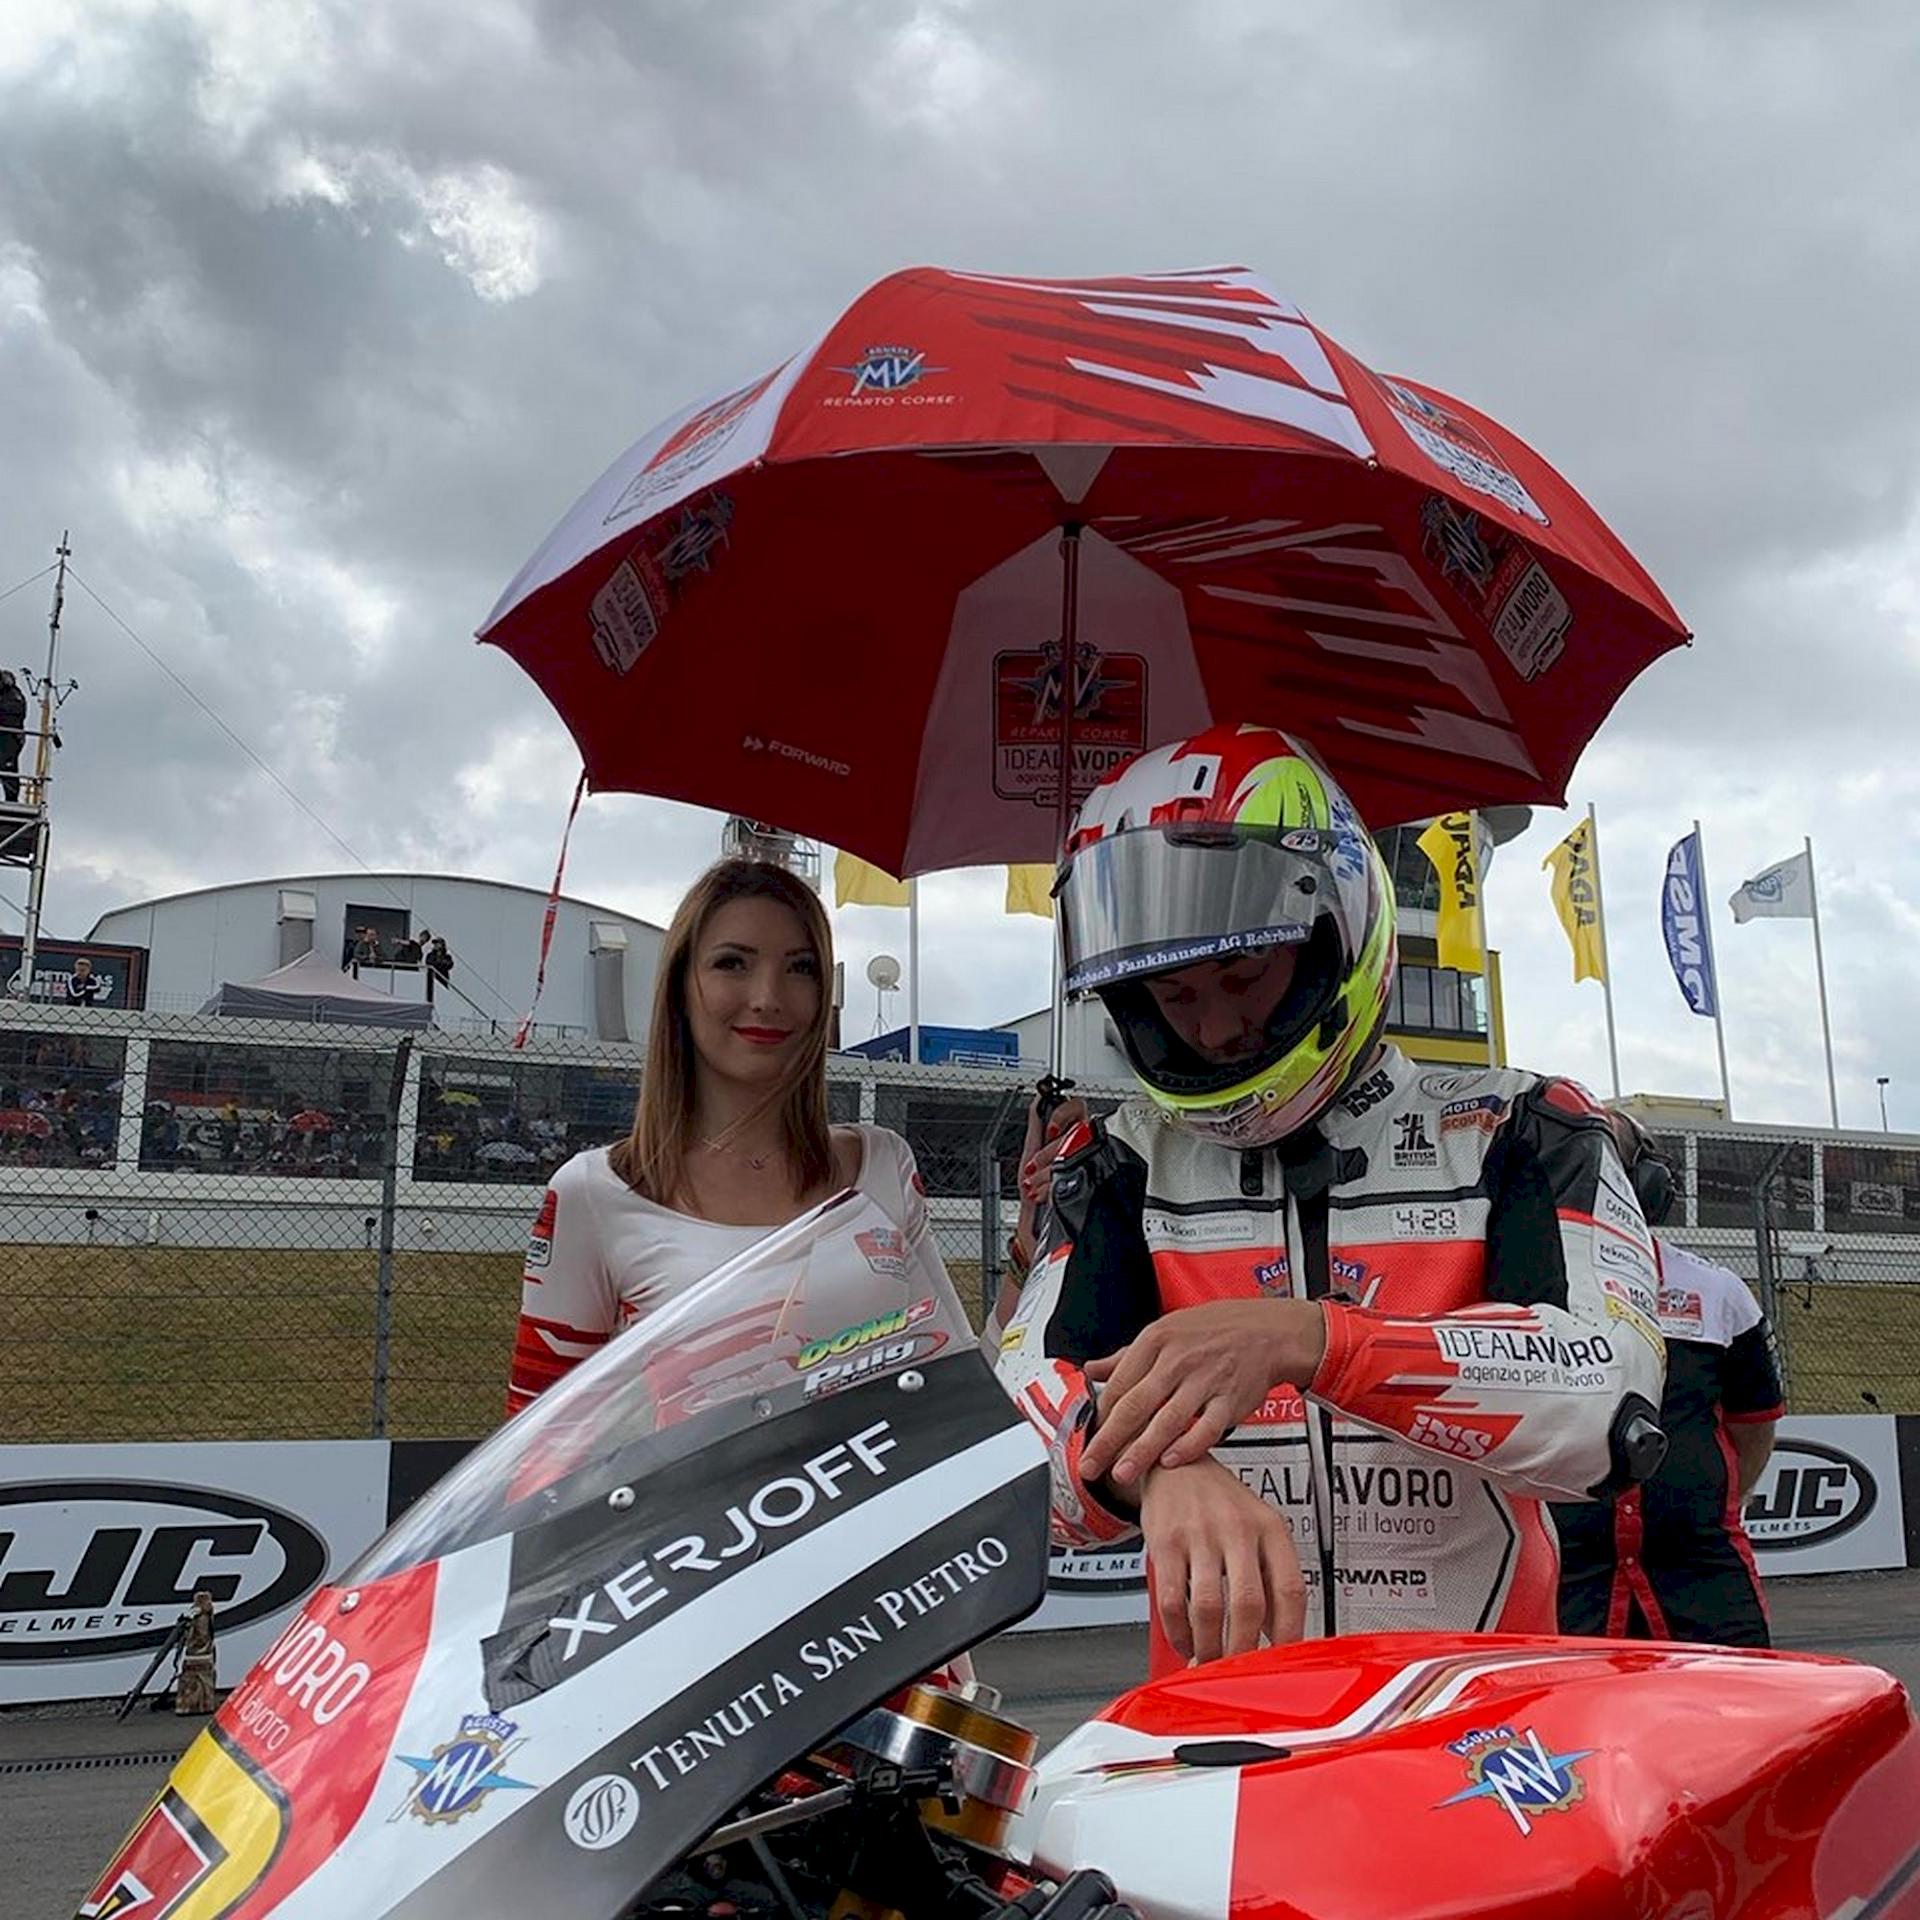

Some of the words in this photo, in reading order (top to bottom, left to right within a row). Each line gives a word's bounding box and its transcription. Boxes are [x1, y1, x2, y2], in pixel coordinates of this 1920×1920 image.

[823, 397, 894, 407] REPARTO
[901, 395, 955, 405] CORSE
[1010, 727, 1062, 738] REPAR
[769, 740, 851, 775] FORWARD
[1117, 942, 1216, 974] Fankhauser
[1218, 936, 1242, 952] AG
[1396, 1208, 1457, 1230] 4:20
[803, 1340, 915, 1393] Puig
[1462, 1364, 1521, 1385] agenzia
[1525, 1368, 1547, 1386] per
[1744, 1467, 1848, 1521] JC
[1357, 1511, 1368, 1533] il
[1374, 1511, 1436, 1536] lavoro
[1749, 1521, 1812, 1534] ELMETS
[548, 1419, 898, 1662] XERJOFF
[0, 1524, 264, 1613] JC
[1061, 1558, 1141, 1574] HELME
[1302, 1568, 1428, 1587] ORWARD
[1307, 1587, 1428, 1599] ACING
[0, 1612, 155, 1633] ELMETS
[631, 1671, 803, 1791] TENUTA
[799, 1615, 882, 1681] SAN
[874, 1535, 1010, 1630] PIETRO
[240, 1684, 290, 1751] lavoro
[1455, 1728, 1511, 1754] AGUSTA
[386, 1738, 530, 1823] MV
[1484, 1726, 1564, 1837] MV
